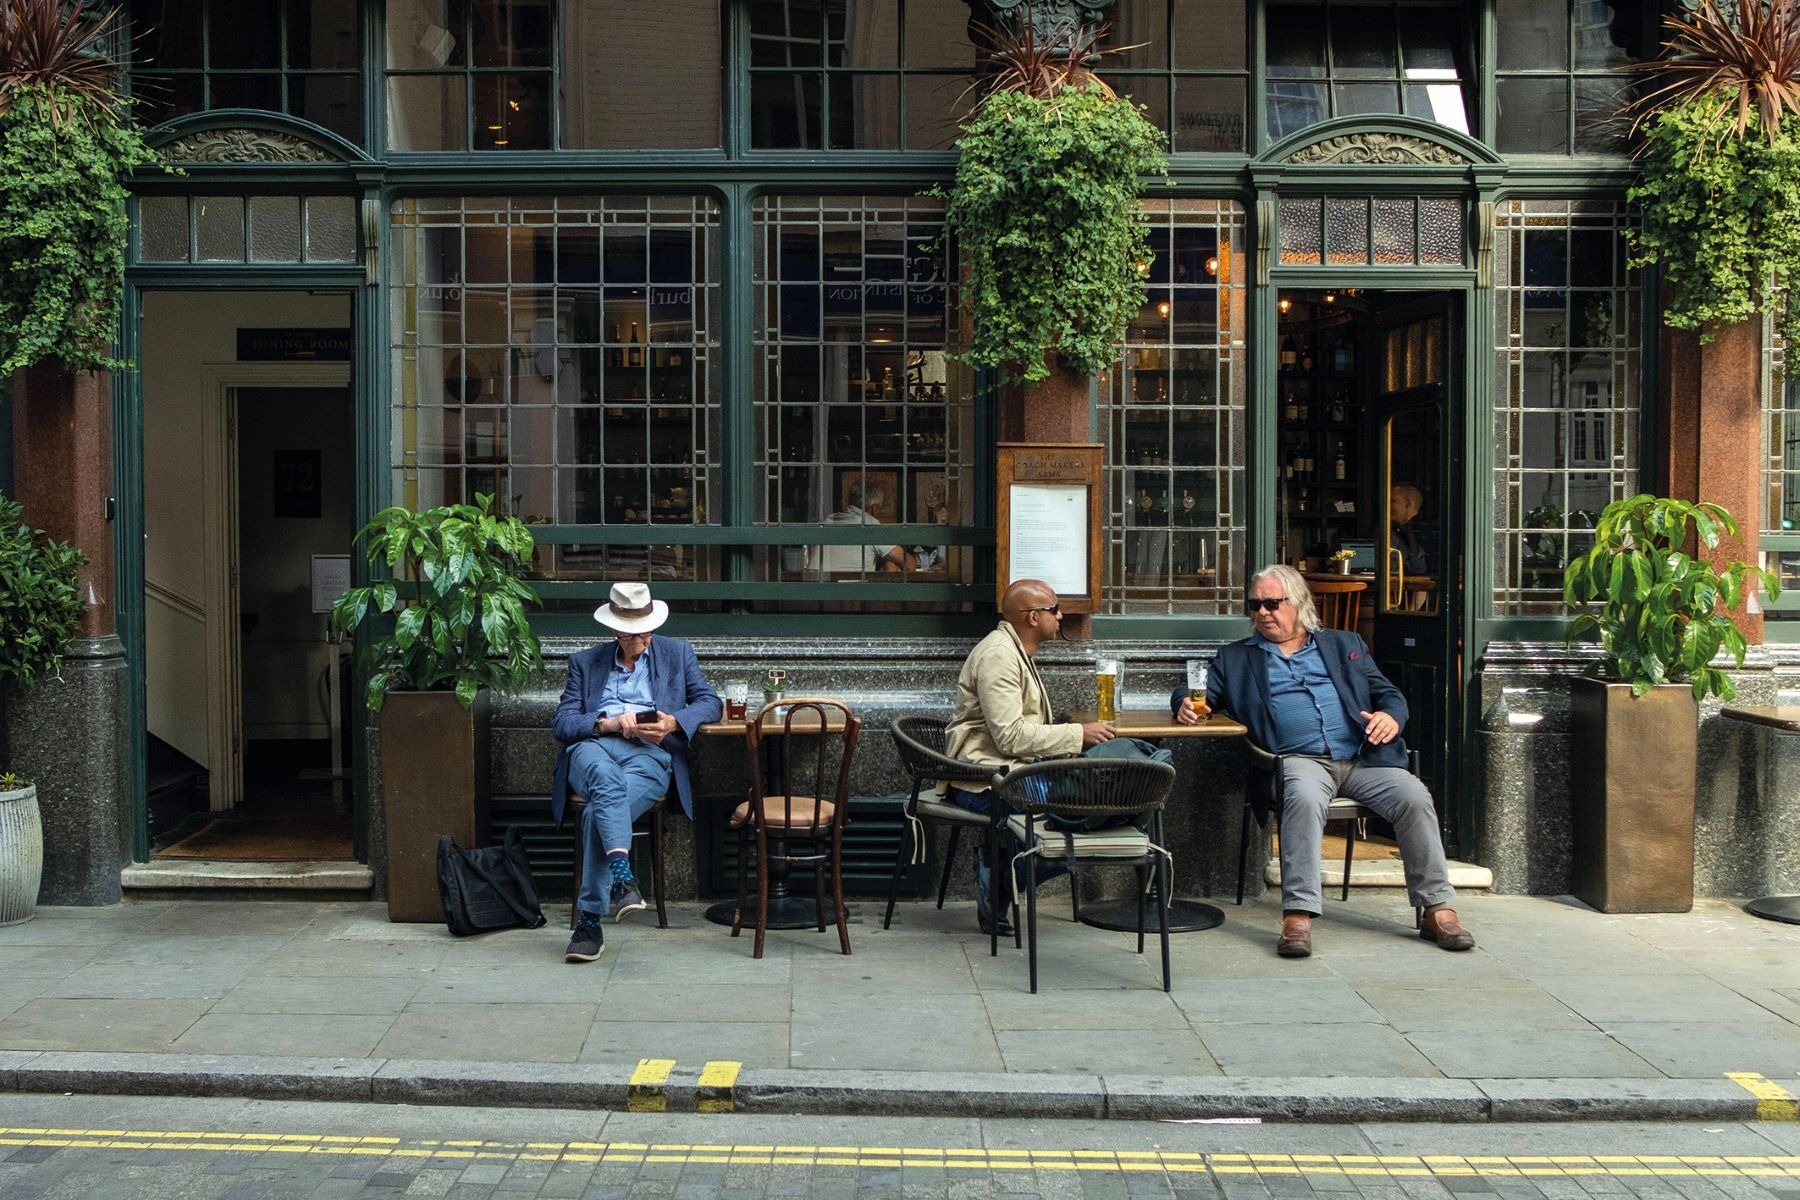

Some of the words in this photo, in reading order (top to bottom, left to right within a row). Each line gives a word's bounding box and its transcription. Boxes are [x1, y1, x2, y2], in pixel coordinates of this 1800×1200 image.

[254, 339, 303, 350] DINING
[310, 339, 349, 350] ROOM
[280, 461, 314, 491] 72
